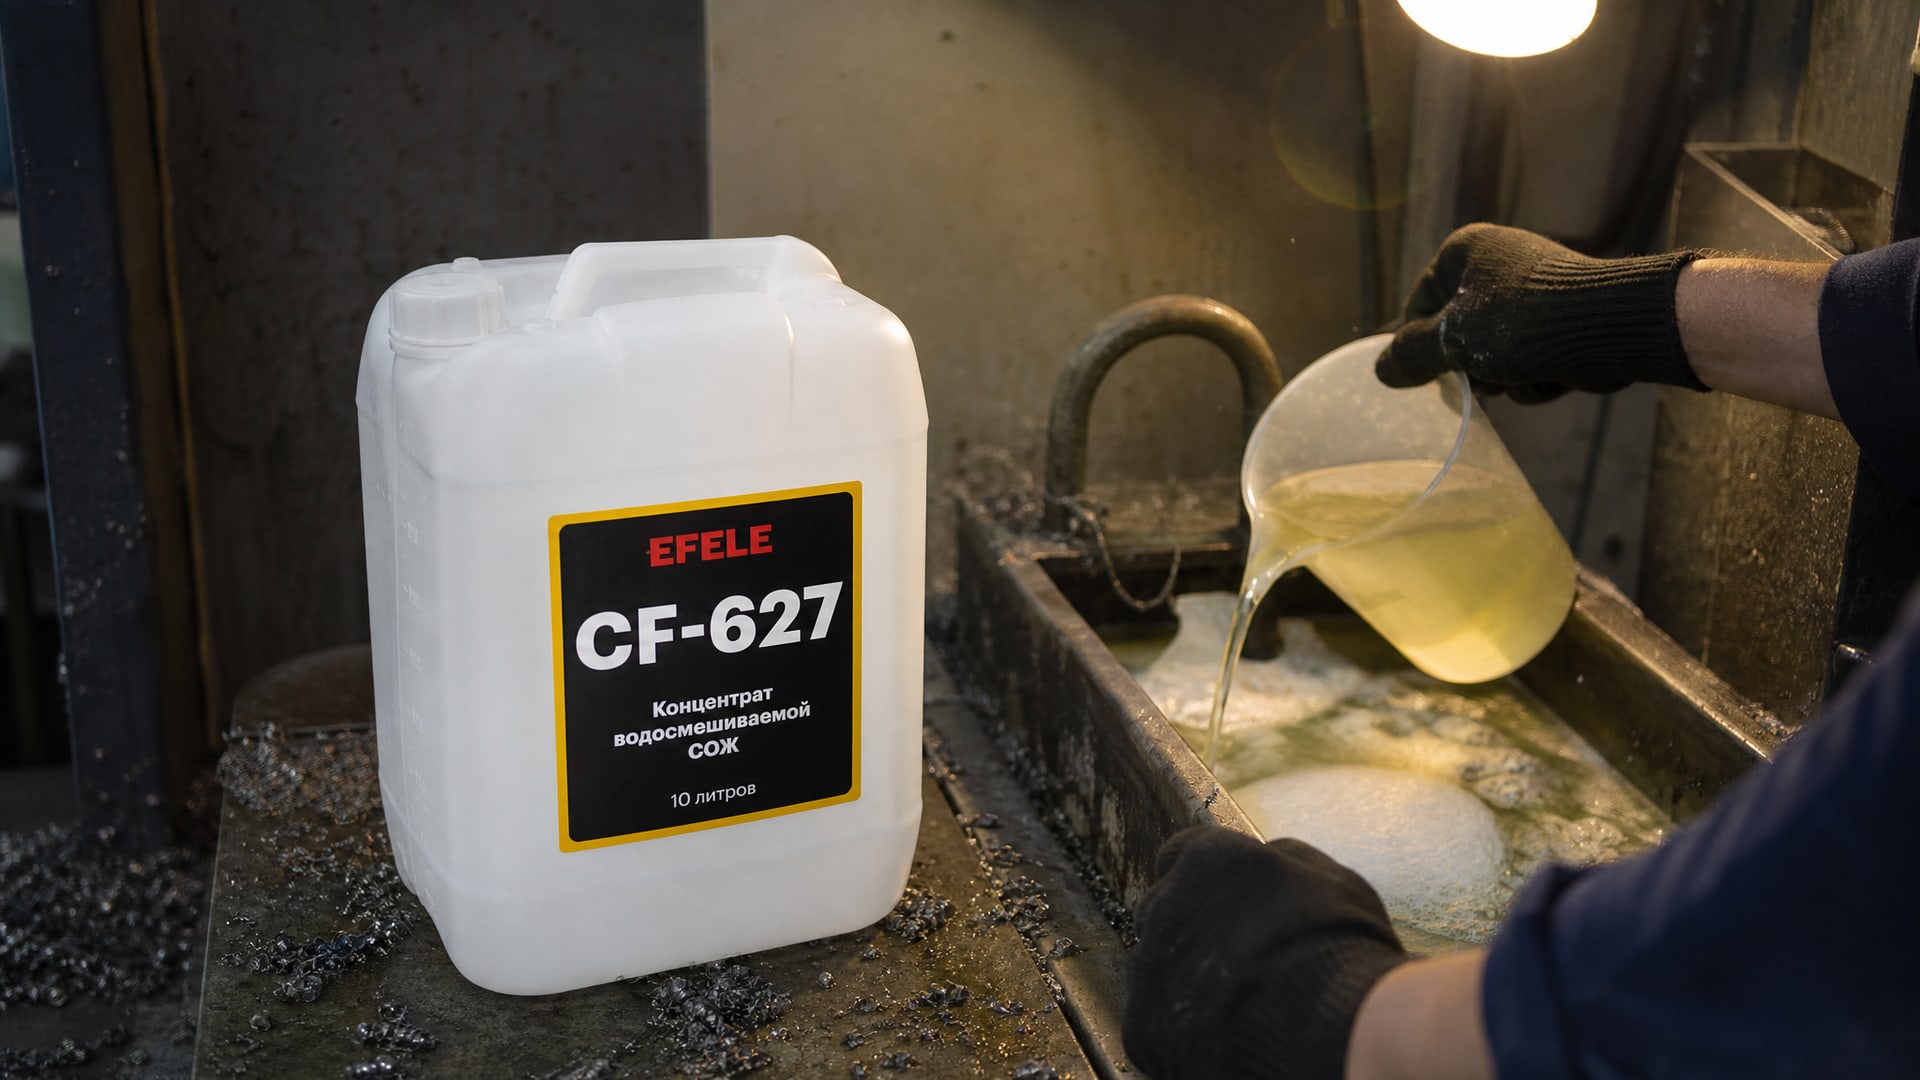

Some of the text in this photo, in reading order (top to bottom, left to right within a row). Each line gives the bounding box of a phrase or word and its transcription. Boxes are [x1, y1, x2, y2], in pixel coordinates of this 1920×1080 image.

[649, 524, 773, 567] EFELE
[575, 581, 844, 671] CF-627
[652, 687, 774, 718] Концентрат
[614, 700, 811, 747] водосмешиваемой
[688, 736, 740, 760] СОЖ
[670, 783, 756, 808] 10 литров
